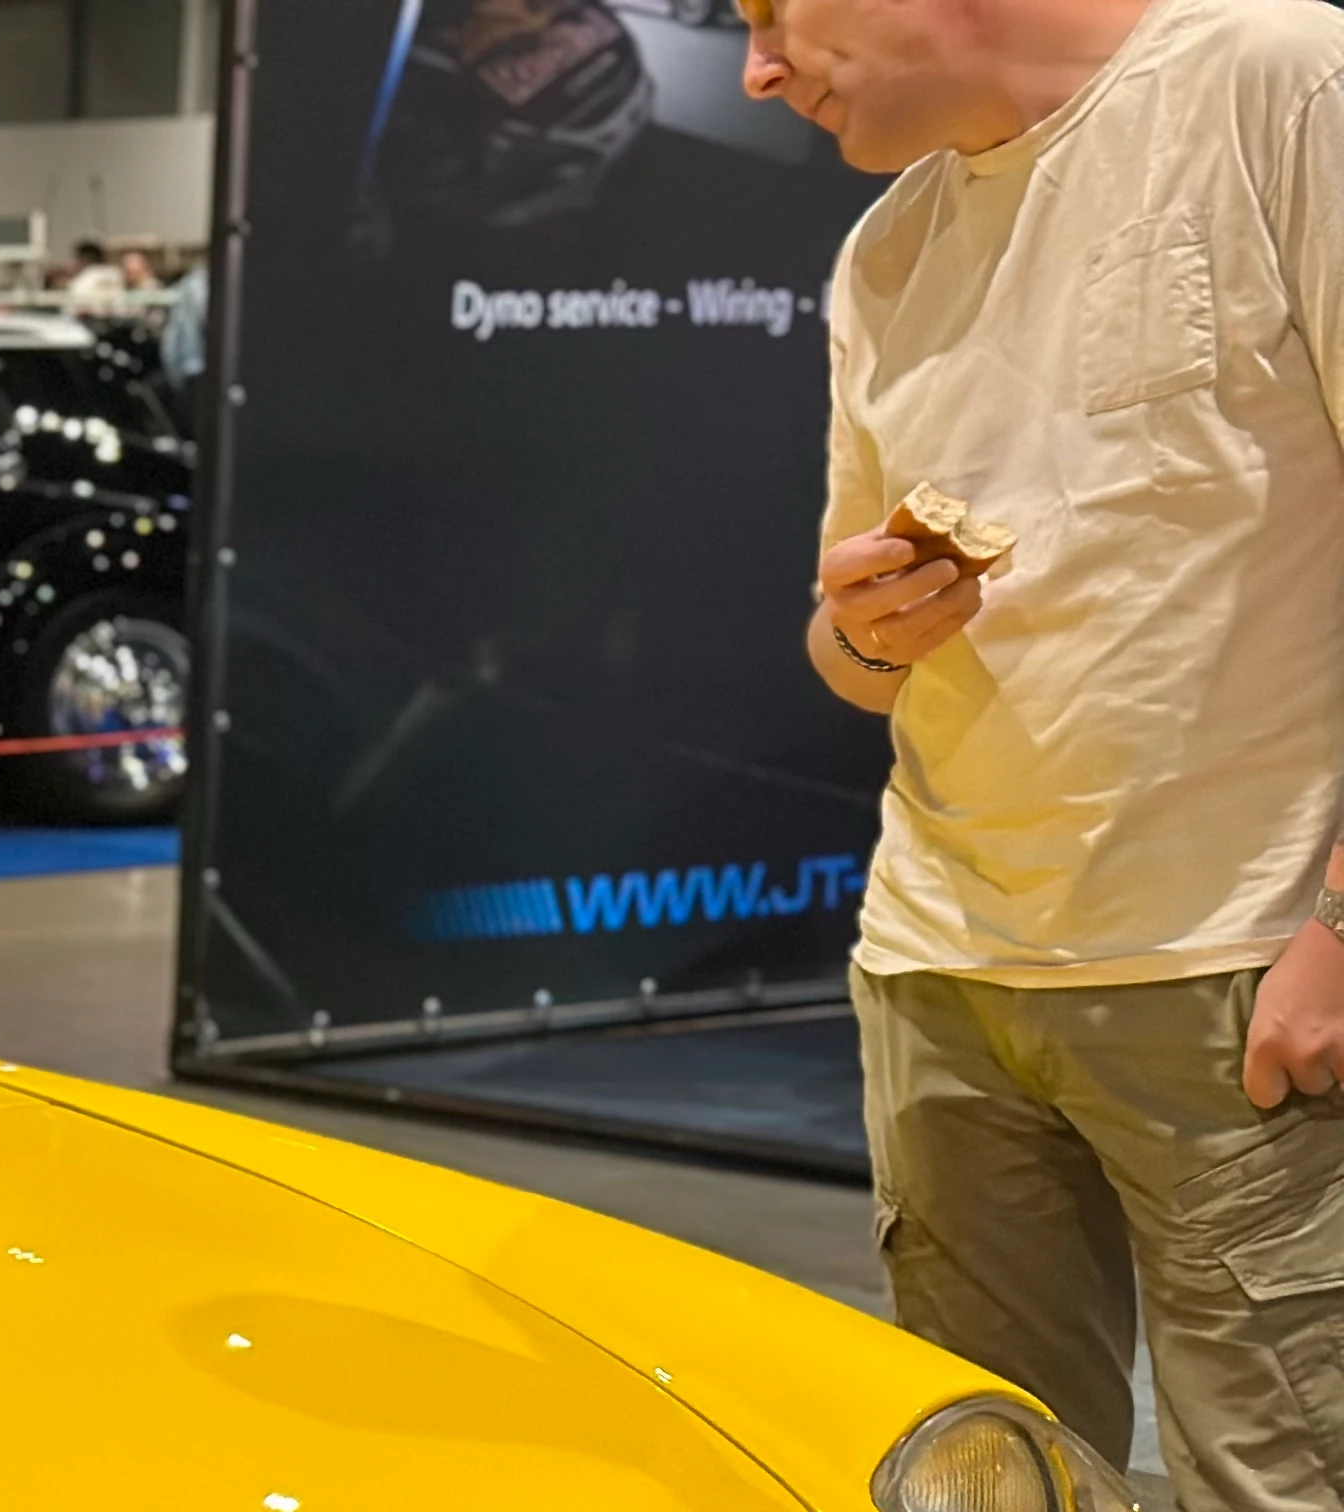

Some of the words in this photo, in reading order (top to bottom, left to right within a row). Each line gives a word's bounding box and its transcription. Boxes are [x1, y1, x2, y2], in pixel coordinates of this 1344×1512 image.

[451, 279, 543, 341] Dyno
[547, 278, 659, 328] service
[687, 277, 794, 337] Wiring
